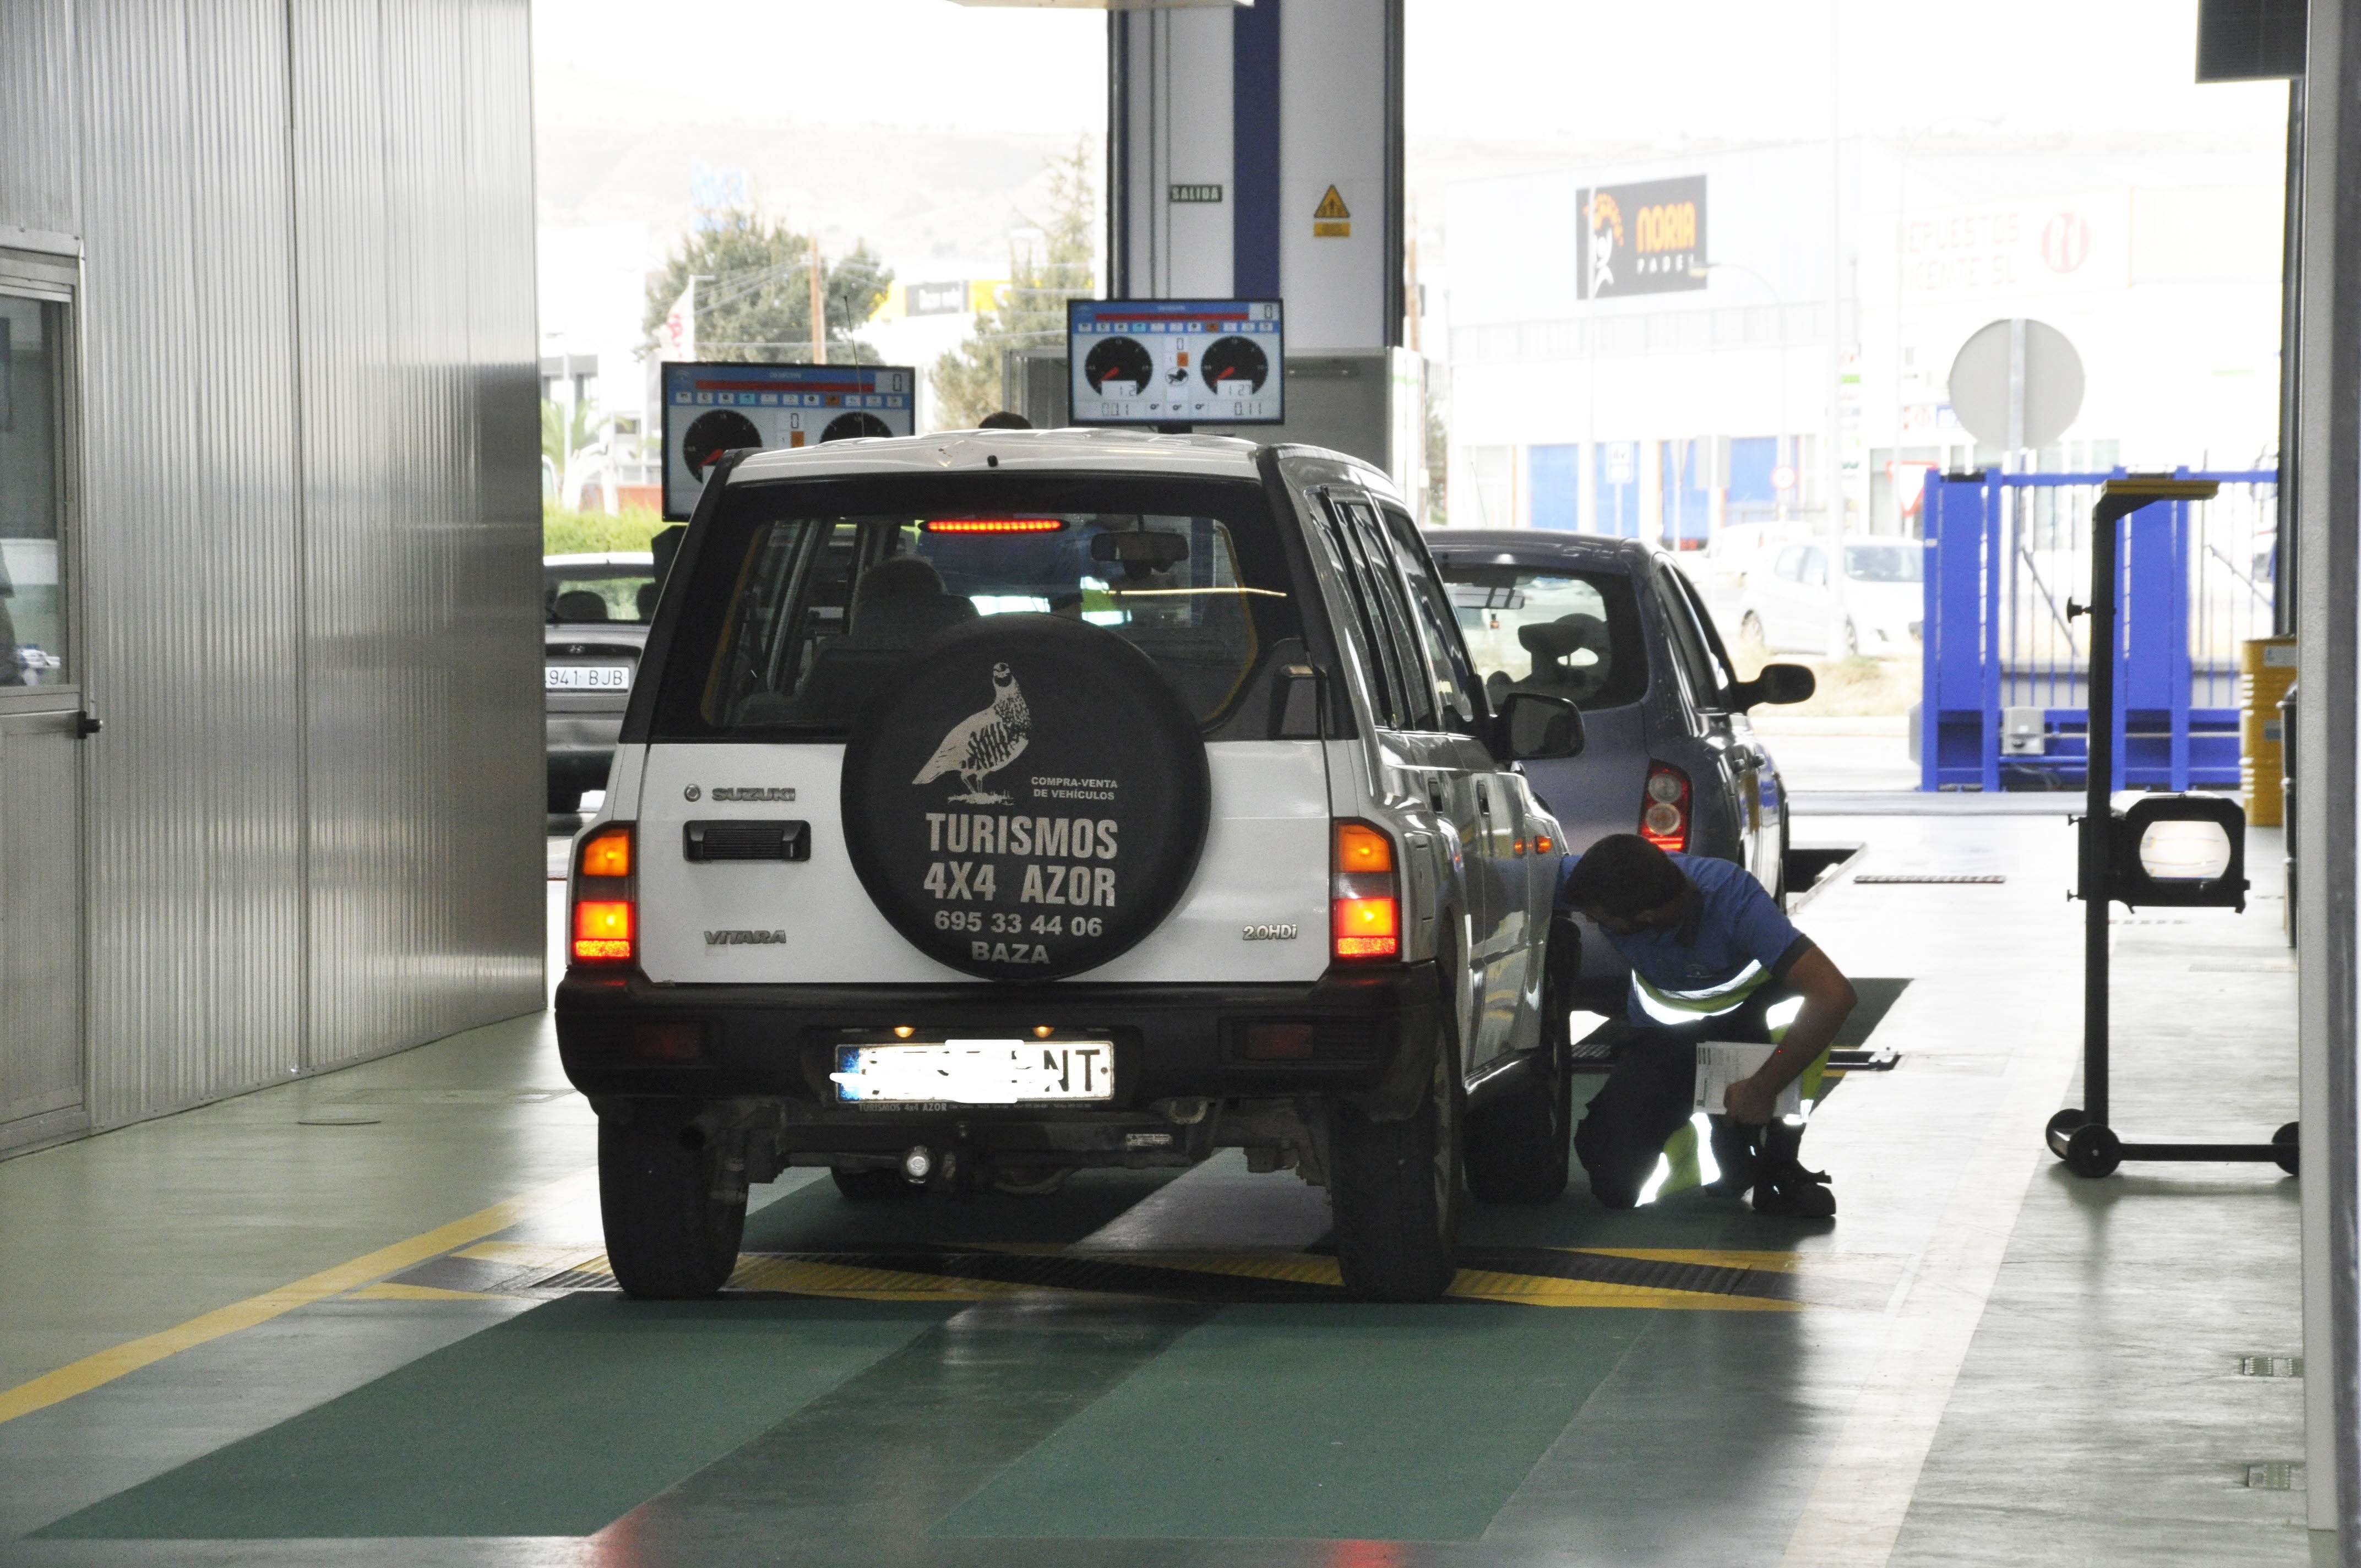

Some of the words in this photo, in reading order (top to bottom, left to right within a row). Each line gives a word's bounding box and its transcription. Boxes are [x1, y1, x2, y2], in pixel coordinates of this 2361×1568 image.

[1172, 186, 1221, 202] SALIDA
[1636, 200, 1696, 253] NORIA
[545, 669, 578, 685] 941
[589, 669, 623, 686] BJB
[1031, 776, 1118, 789] COMPRA-VENTA
[711, 787, 796, 802] SUZUKI
[1033, 789, 1048, 798] DE
[1051, 789, 1115, 801] VEHÍCULOS
[925, 812, 1118, 860] TURISMOS
[923, 862, 997, 901] 4X4
[1020, 865, 1116, 907] AZOR
[934, 911, 982, 933] 695
[990, 912, 1022, 934] 33
[1030, 914, 1063, 936] 44
[1070, 916, 1103, 938] 06
[704, 929, 787, 944] VITARA
[971, 941, 1051, 965] BAZA
[858, 1103, 901, 1112] TURISMOS
[922, 1102, 948, 1112] AZOR
